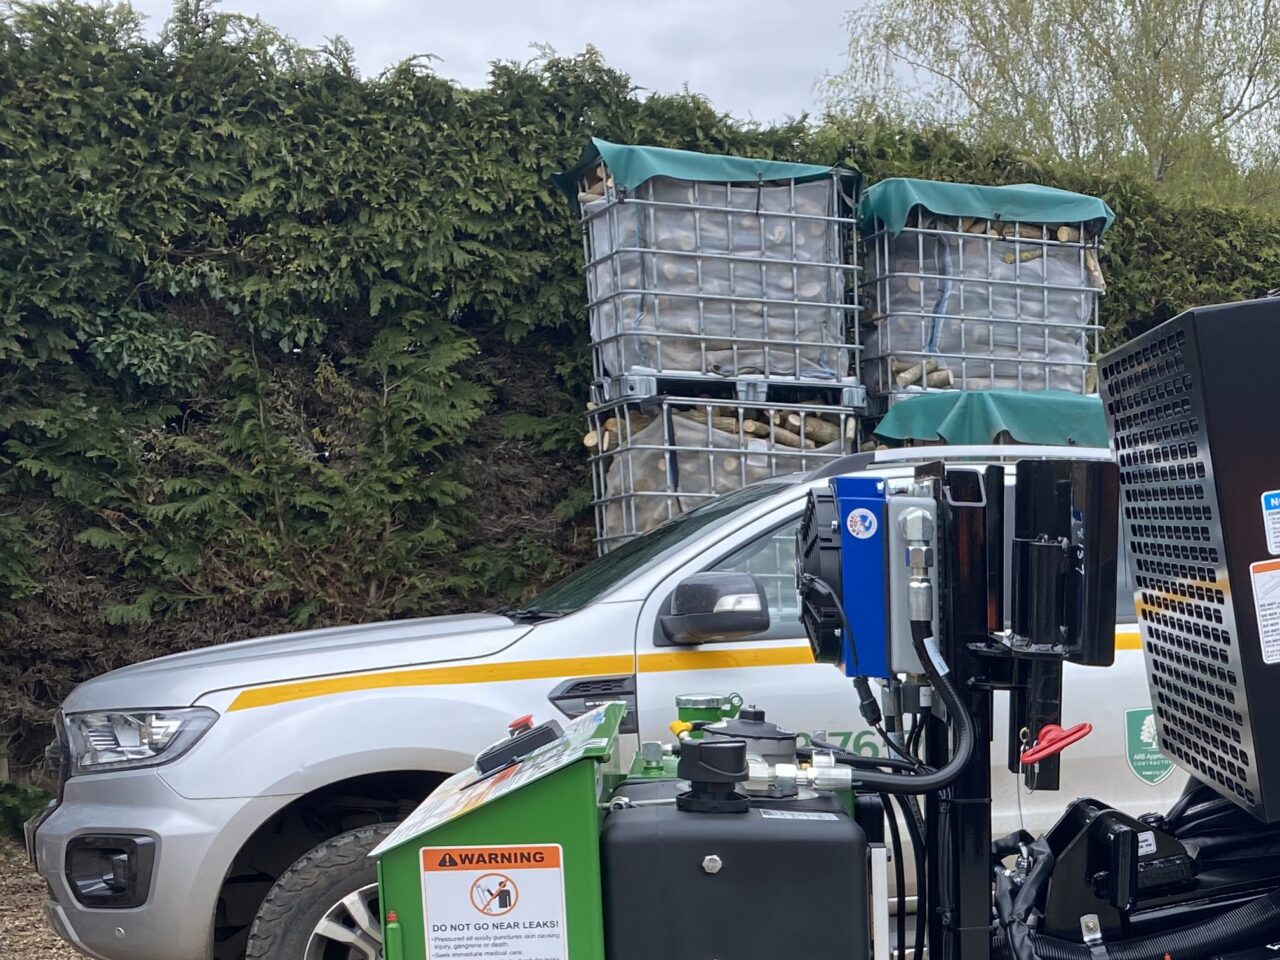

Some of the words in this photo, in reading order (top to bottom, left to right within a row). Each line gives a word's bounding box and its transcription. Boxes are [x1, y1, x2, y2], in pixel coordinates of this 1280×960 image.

[459, 852, 545, 865] WARNING
[433, 924, 448, 932] DO
[474, 923, 489, 931] GO
[492, 922, 520, 930] NEAR
[523, 921, 559, 929] LEAKS!
